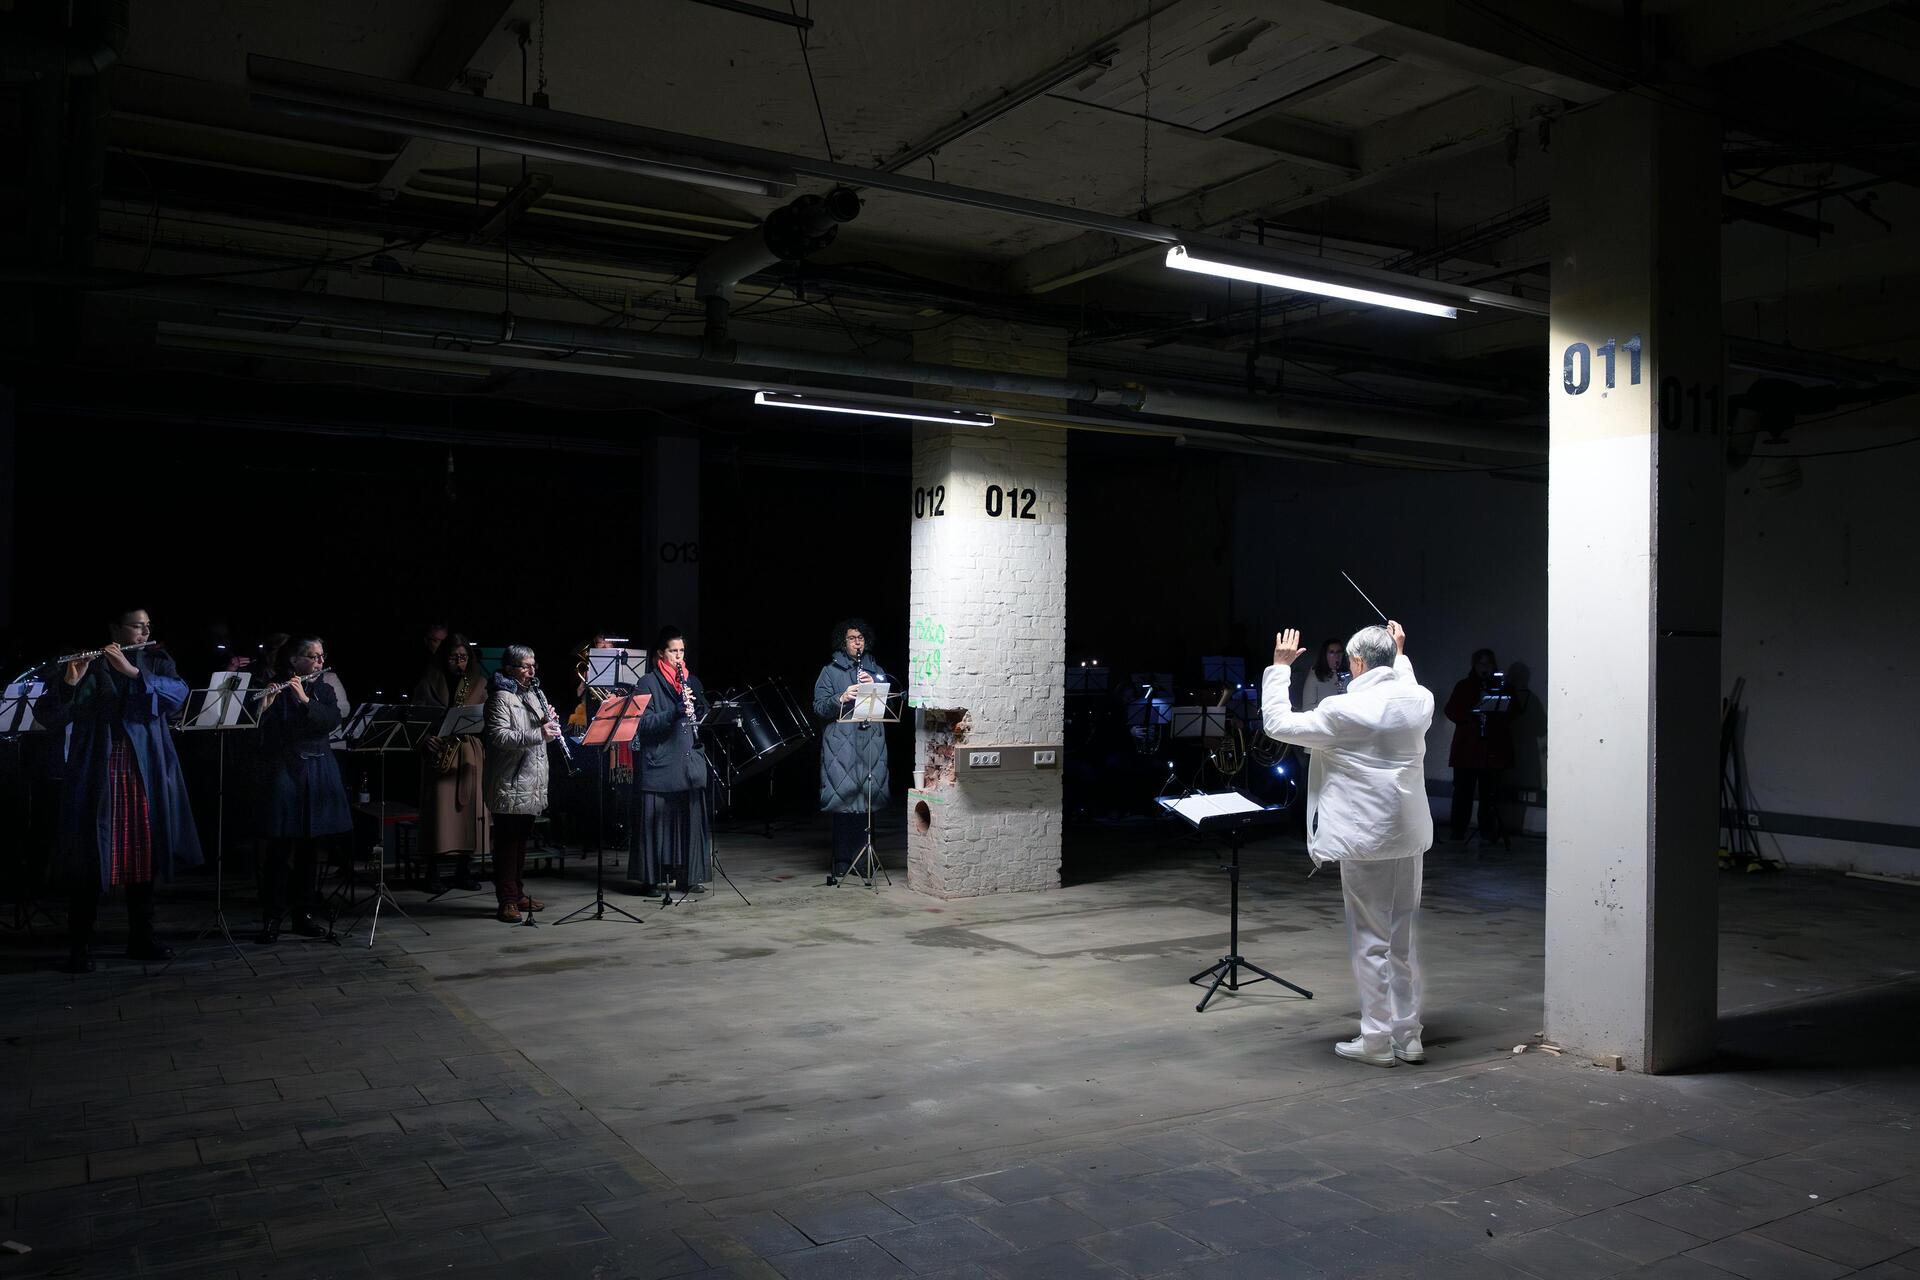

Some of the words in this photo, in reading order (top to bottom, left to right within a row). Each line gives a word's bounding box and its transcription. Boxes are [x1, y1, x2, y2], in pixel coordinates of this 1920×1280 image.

[1563, 333, 1641, 395] 011
[1662, 376, 1719, 434] 011
[915, 485, 946, 519] 012
[985, 484, 1037, 520] 012
